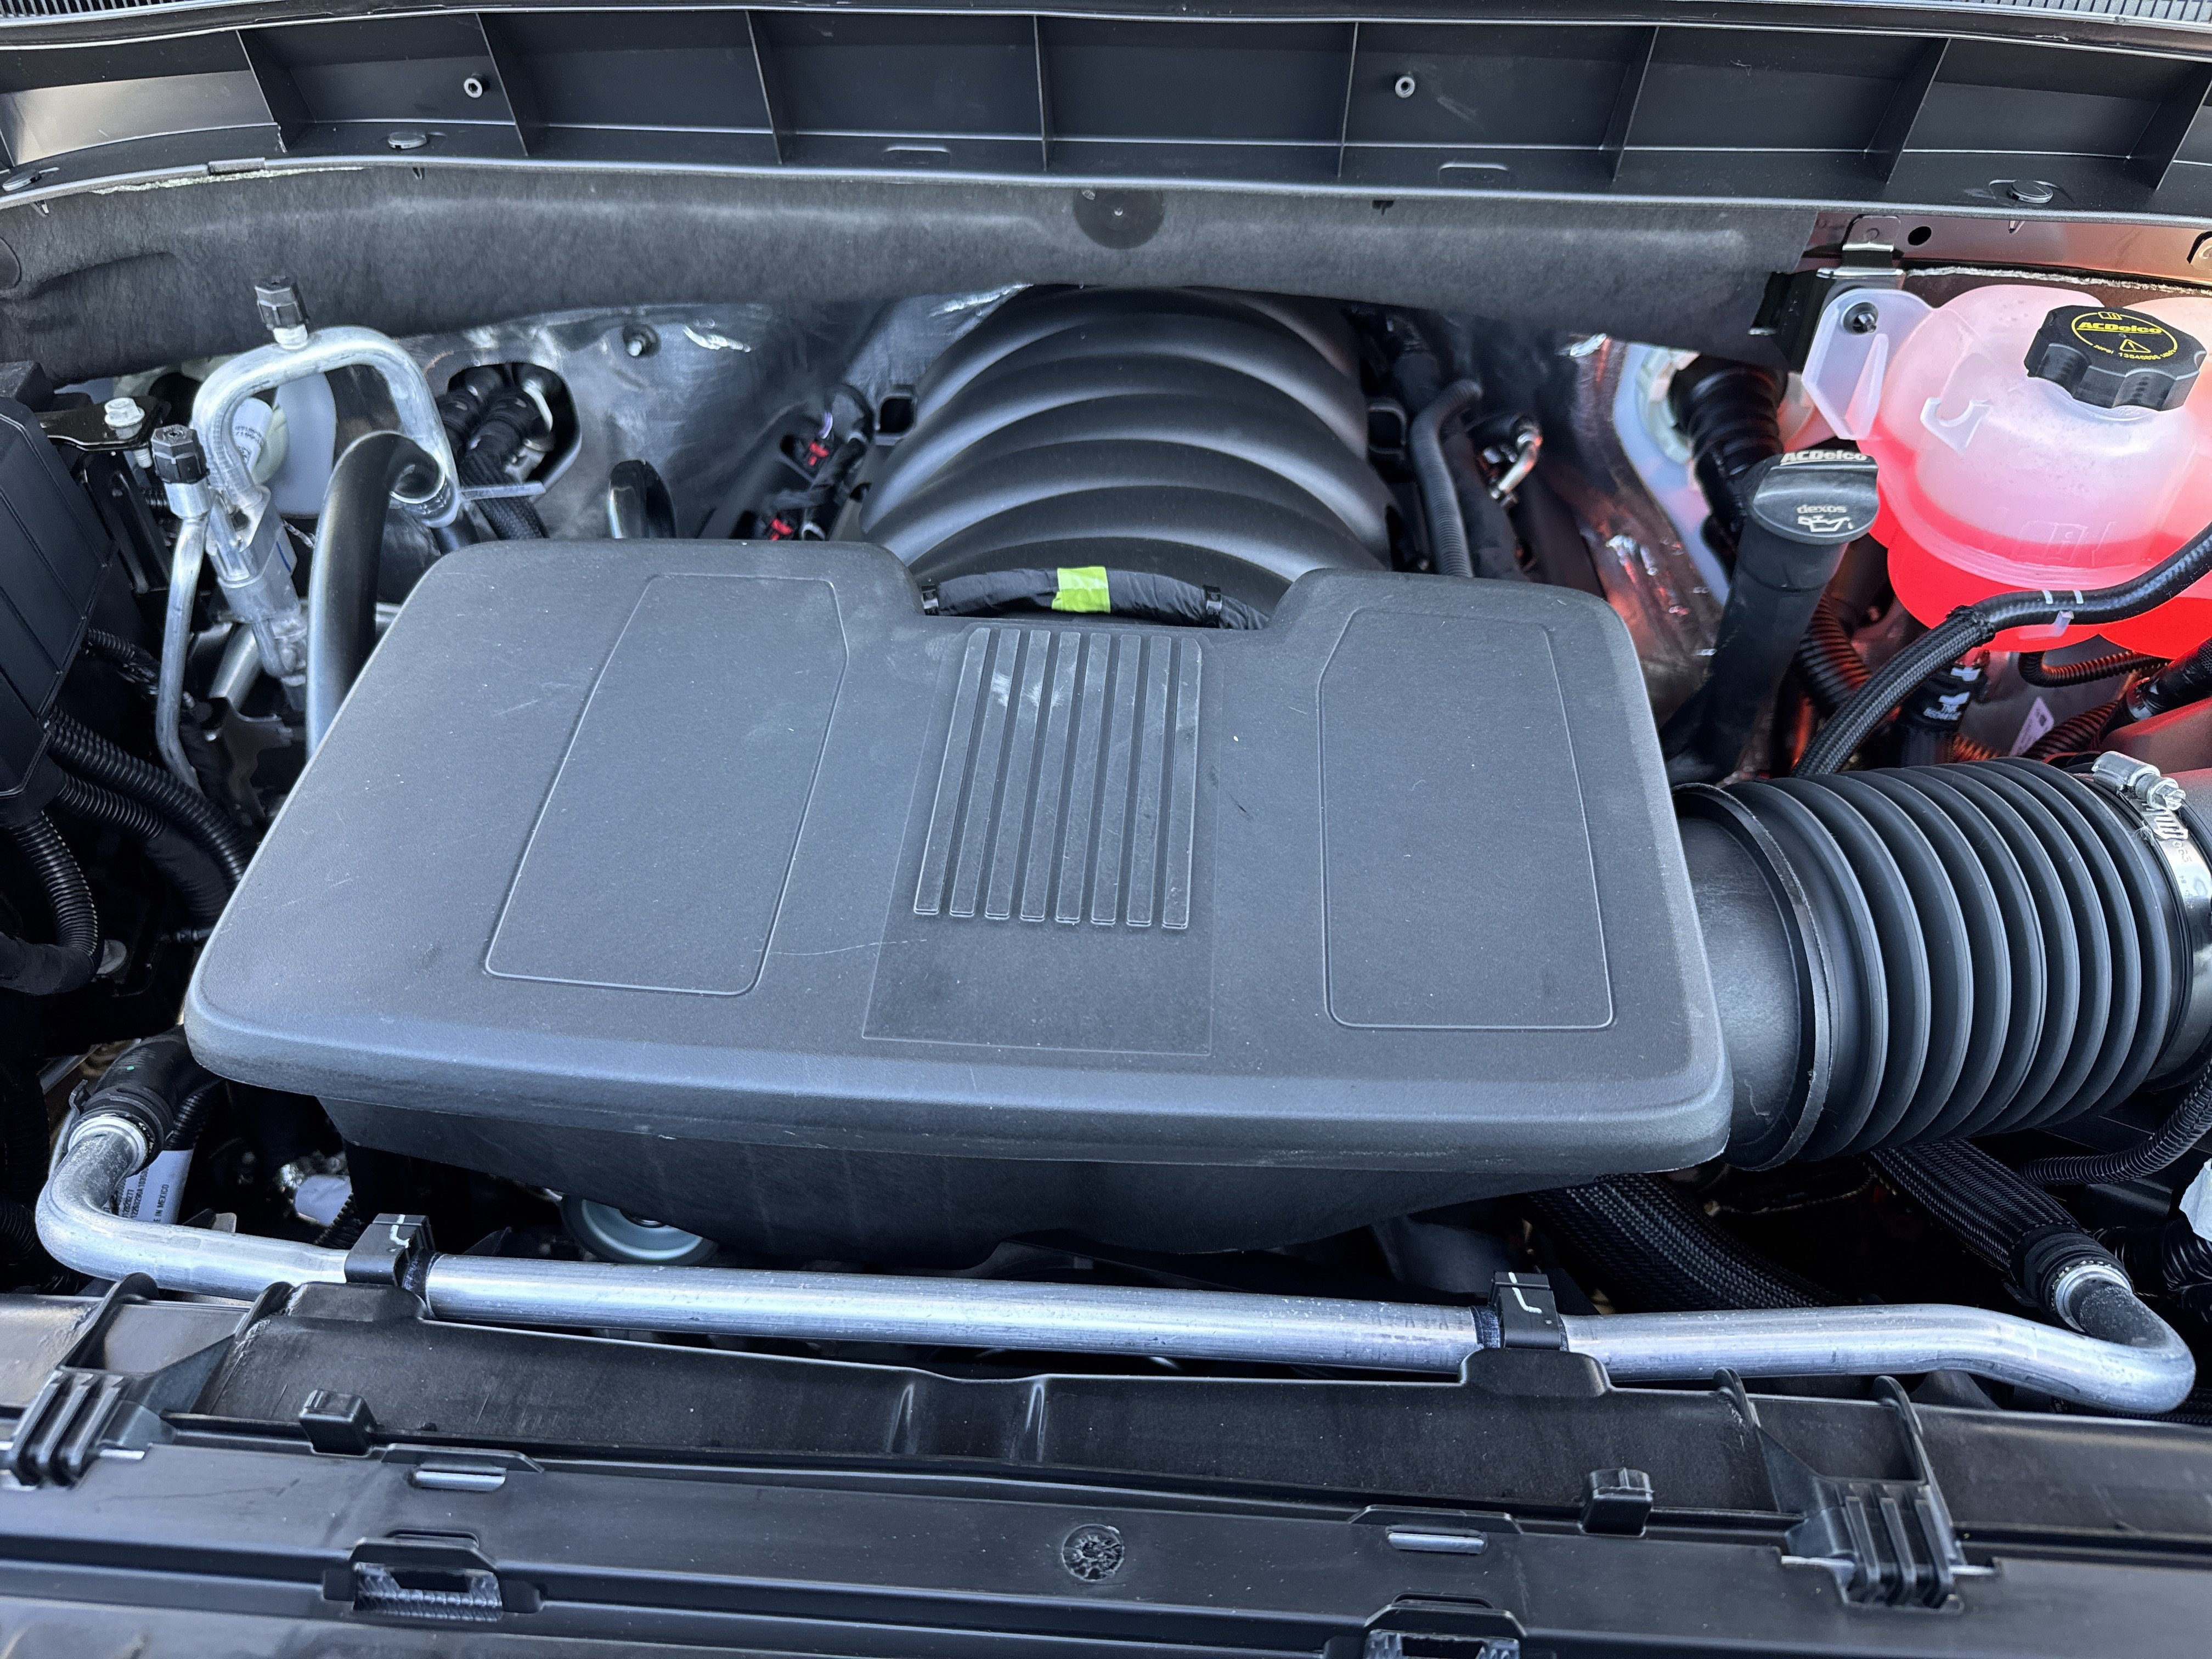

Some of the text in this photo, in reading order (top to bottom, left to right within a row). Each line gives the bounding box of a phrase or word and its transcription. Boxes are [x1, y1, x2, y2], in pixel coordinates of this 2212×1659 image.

[2078, 321, 2163, 334] ACDelco
[1780, 449, 1869, 464] ACDelco
[1797, 504, 1848, 514] dexos
[157, 1184, 170, 1209] MEXICO
